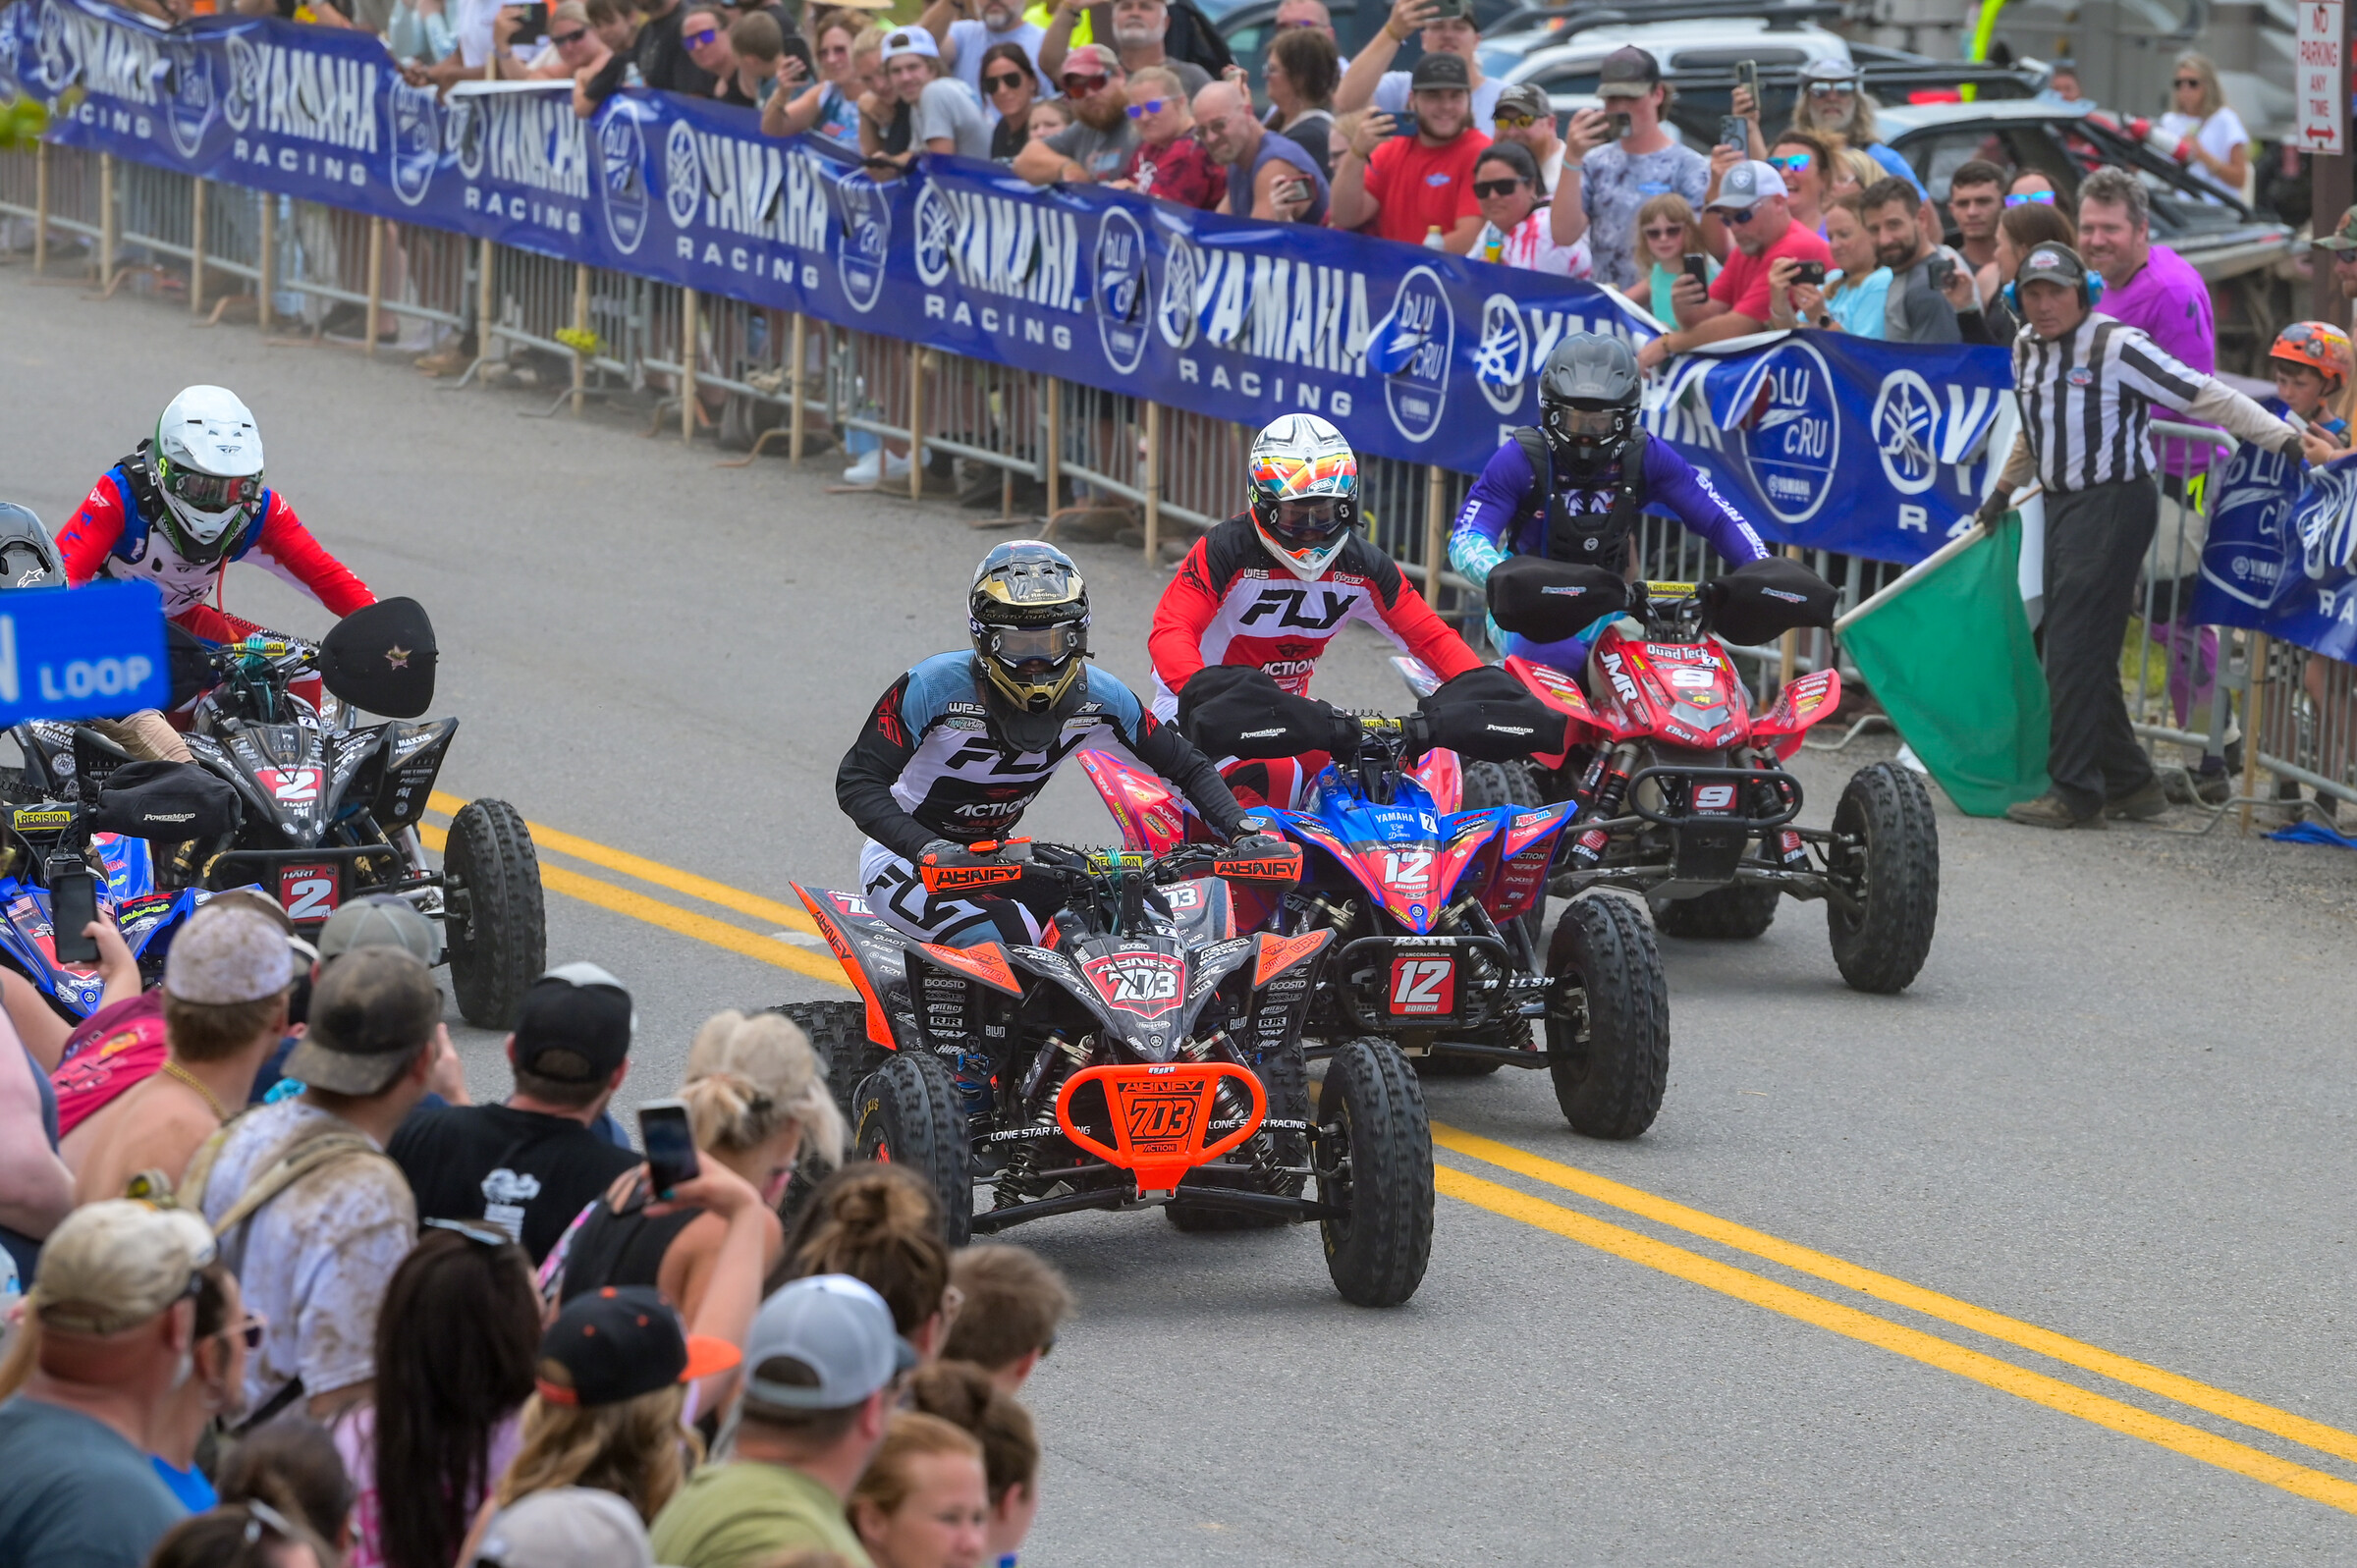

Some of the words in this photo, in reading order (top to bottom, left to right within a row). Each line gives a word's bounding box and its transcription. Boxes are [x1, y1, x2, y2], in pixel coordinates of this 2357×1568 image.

[2313, 8, 2329, 33] NO
[2300, 41, 2337, 67] PARKING
[2310, 75, 2328, 92] ANY
[255, 42, 377, 153] YAMAHA
[2310, 99, 2330, 118] TIME
[234, 137, 366, 187] RACING
[465, 186, 581, 235] RACING
[677, 236, 819, 290] RACING
[925, 294, 1072, 351] RACING
[1179, 358, 1352, 417] RACING
[1239, 589, 1359, 629] FLY
[1647, 644, 1681, 661] Quad
[1683, 647, 1709, 659] Tech
[1258, 656, 1319, 676] ACTION
[40, 655, 152, 701] LOOP
[1599, 650, 1639, 706] JMR
[1672, 669, 1715, 687] 9
[398, 733, 432, 748] MAXXIS
[1666, 725, 1692, 741] Elka
[1717, 730, 1736, 747] Elka
[945, 733, 1091, 776] FLY
[275, 771, 317, 800] 2
[954, 790, 1035, 818] ACTION
[1695, 785, 1734, 808] 9
[1375, 812, 1414, 823] YAMAHA
[1425, 816, 1433, 831] 2
[1515, 809, 1552, 828] AMSOIL
[1571, 843, 1600, 862] Elka
[283, 870, 316, 880] HART
[936, 868, 1019, 886] ABNEY
[1217, 861, 1298, 877] ABNEY
[1383, 852, 1433, 884] 12
[288, 879, 332, 920] 2
[812, 910, 853, 960] ABNEY
[1393, 937, 1458, 946] RATH
[1096, 958, 1177, 975] ABNEY
[1108, 968, 1176, 1000] 703
[1394, 960, 1452, 1003] 12
[1123, 1081, 1198, 1093] ABNEY
[1129, 1099, 1195, 1139] 703
[1208, 1120, 1236, 1130] LONE
[1270, 1119, 1306, 1130] RACING
[991, 1130, 1018, 1142] LONE
[1021, 1127, 1049, 1138] STAR
[1144, 1144, 1177, 1153] ACTION
